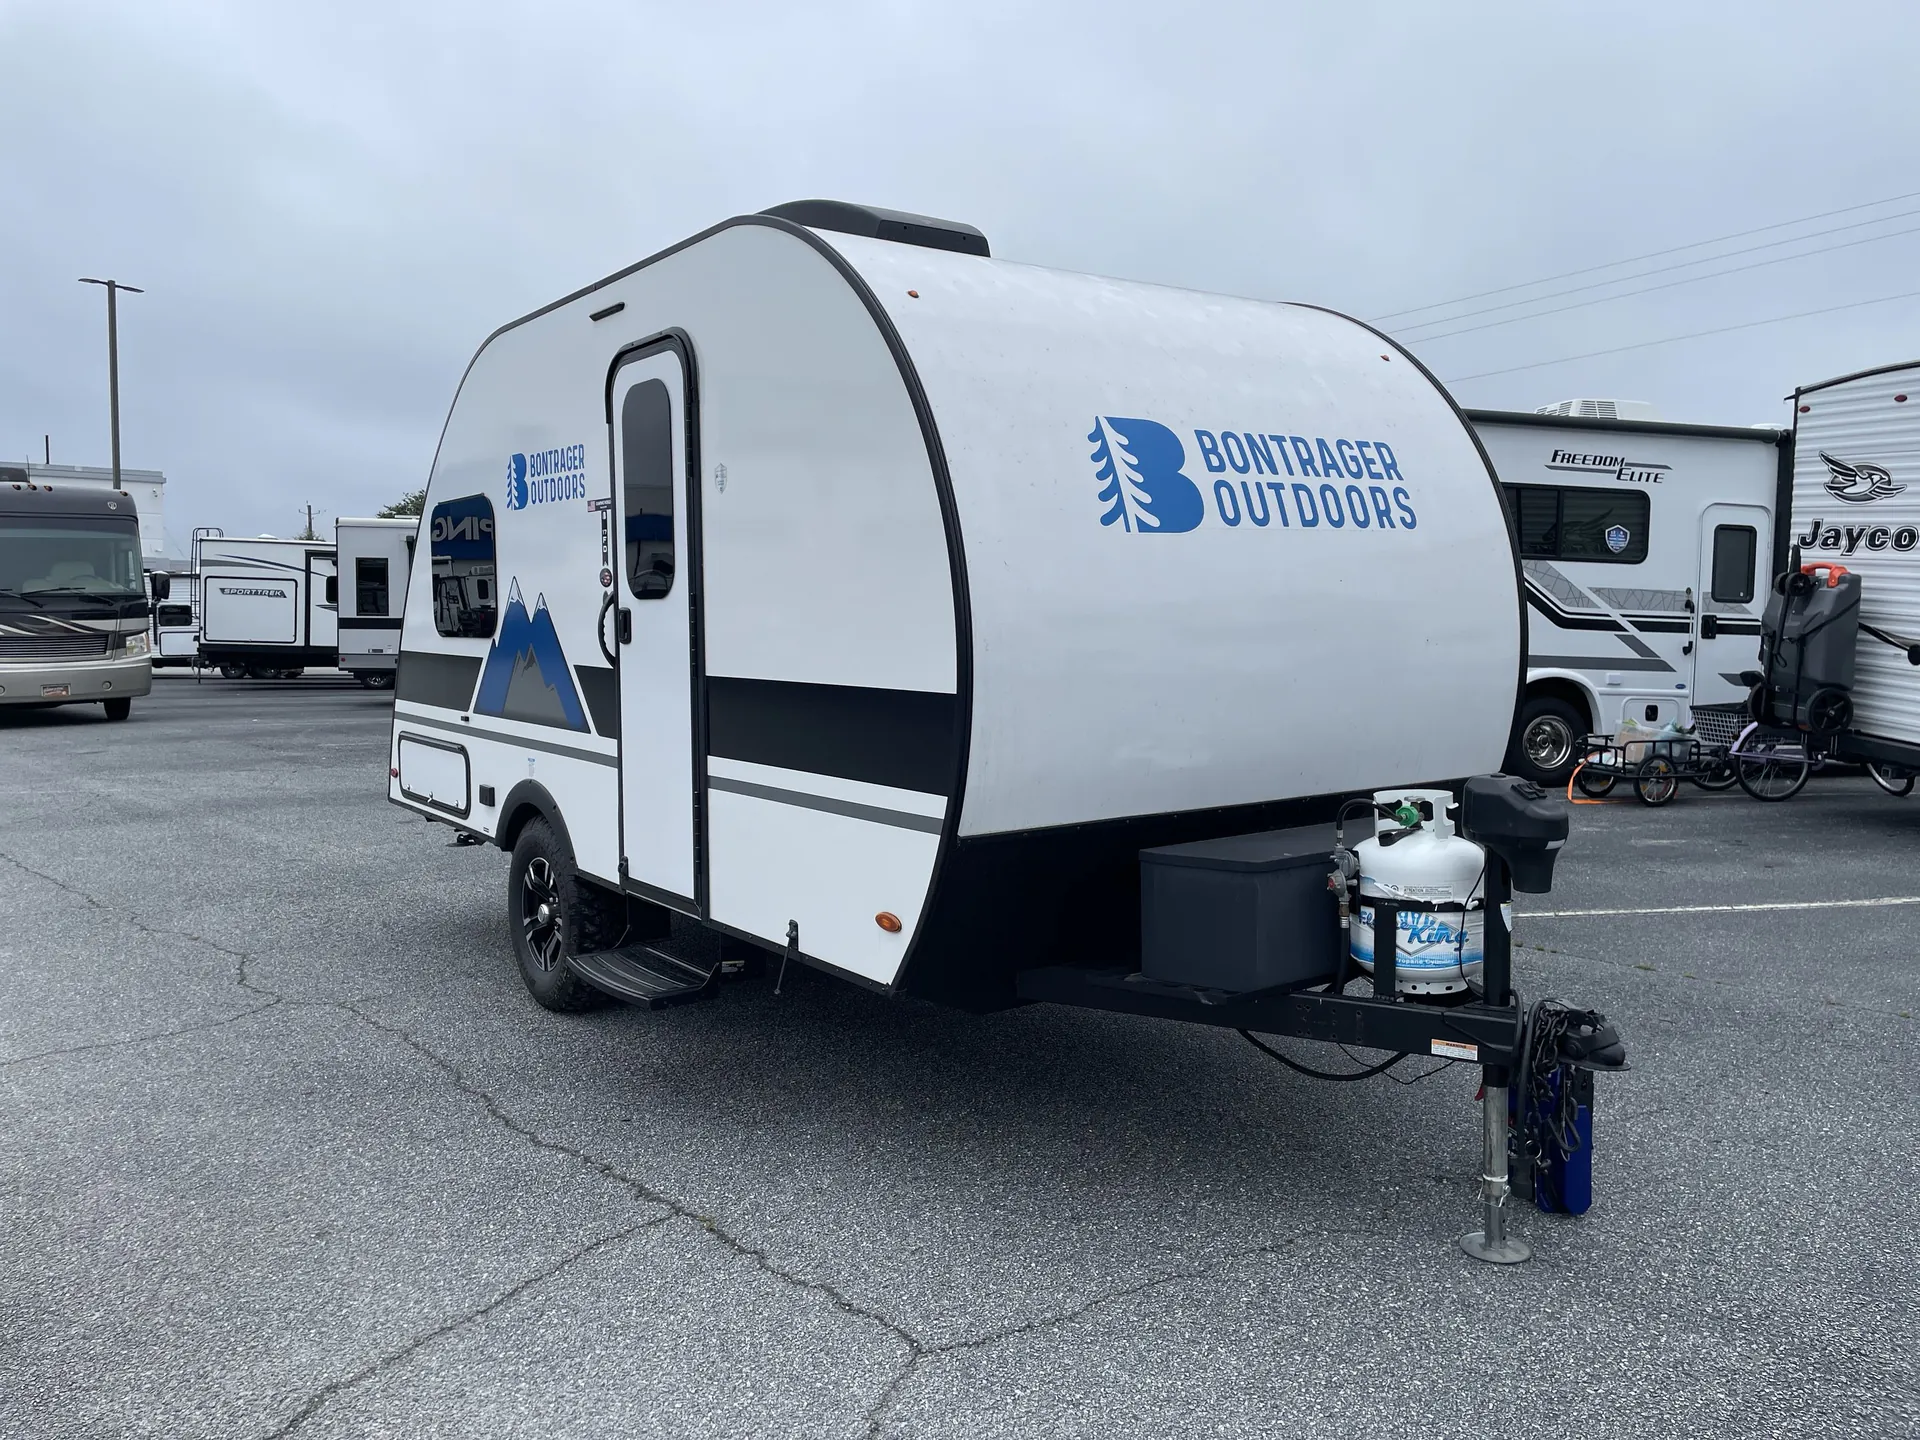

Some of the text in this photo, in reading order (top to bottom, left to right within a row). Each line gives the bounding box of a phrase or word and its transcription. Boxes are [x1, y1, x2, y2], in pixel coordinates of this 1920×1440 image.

[530, 444, 585, 478] BONTRAGER
[1194, 430, 1404, 481] BONTRAGER
[1551, 449, 1625, 468] FREEDOM
[531, 473, 586, 504] OUTDOORS
[1616, 467, 1665, 484] ELITE
[1213, 479, 1417, 530] OUTDOORS
[1798, 518, 1919, 556] Jayco
[223, 588, 282, 596] SPORTTREK
[1407, 922, 1470, 952] King
